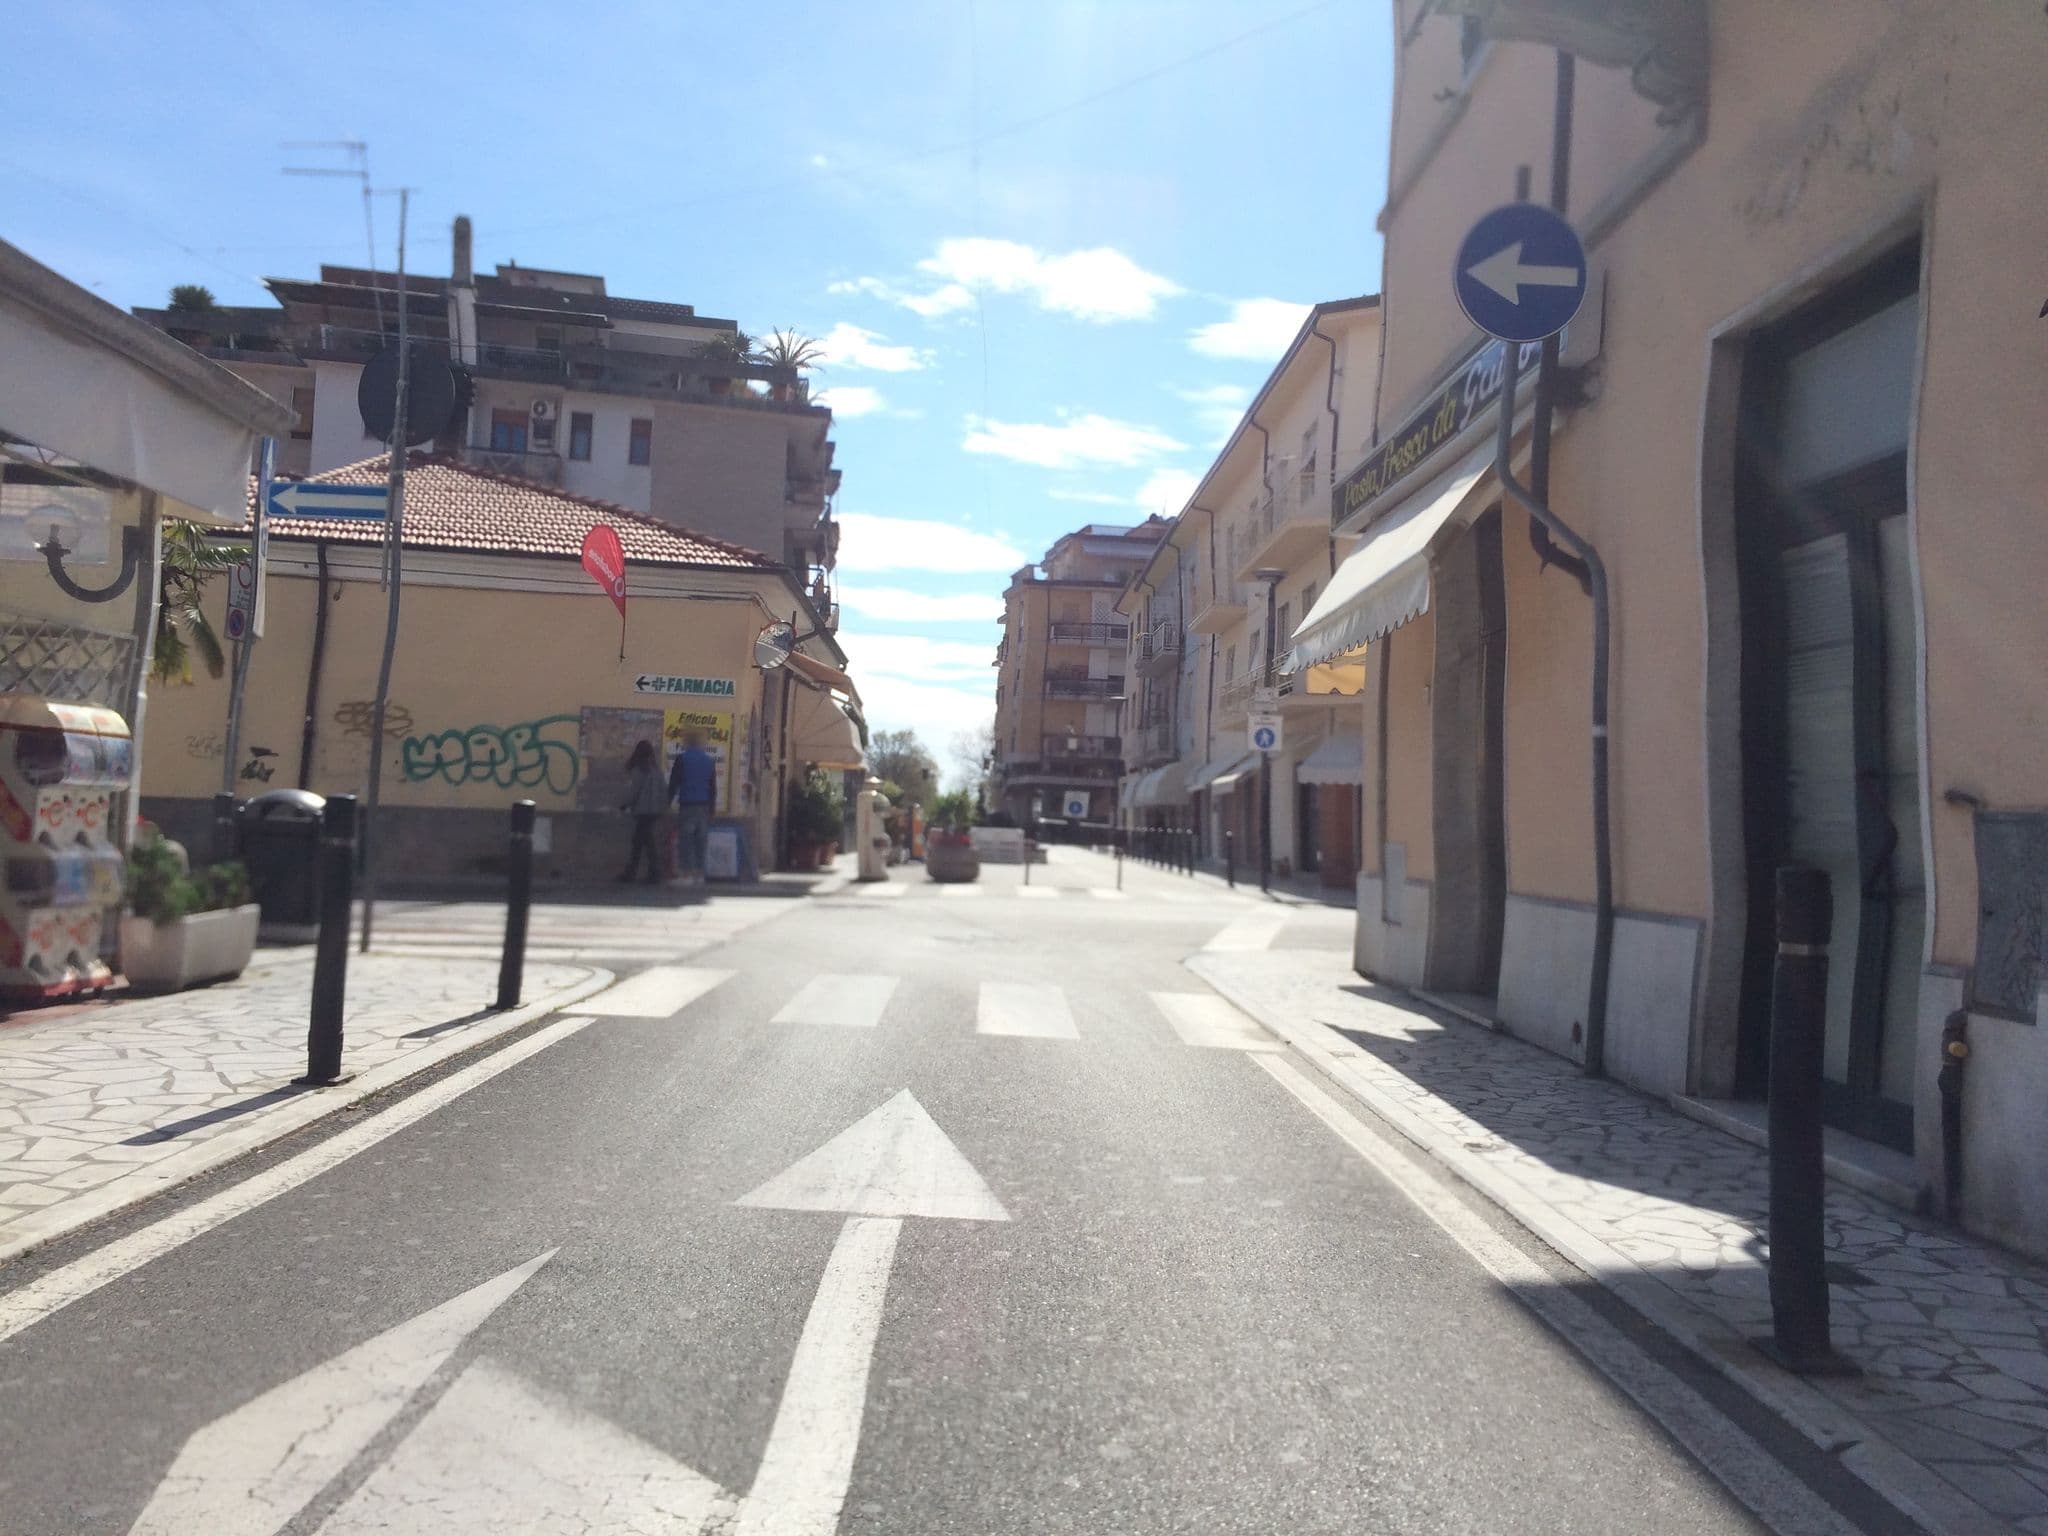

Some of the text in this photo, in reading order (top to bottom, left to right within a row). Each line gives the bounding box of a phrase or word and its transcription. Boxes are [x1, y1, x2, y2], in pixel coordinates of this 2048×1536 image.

[1343, 469, 1377, 516] Pasta
[1433, 391, 1457, 444] da
[667, 678, 735, 696] FARMACIA
[678, 711, 719, 726] Edicola
